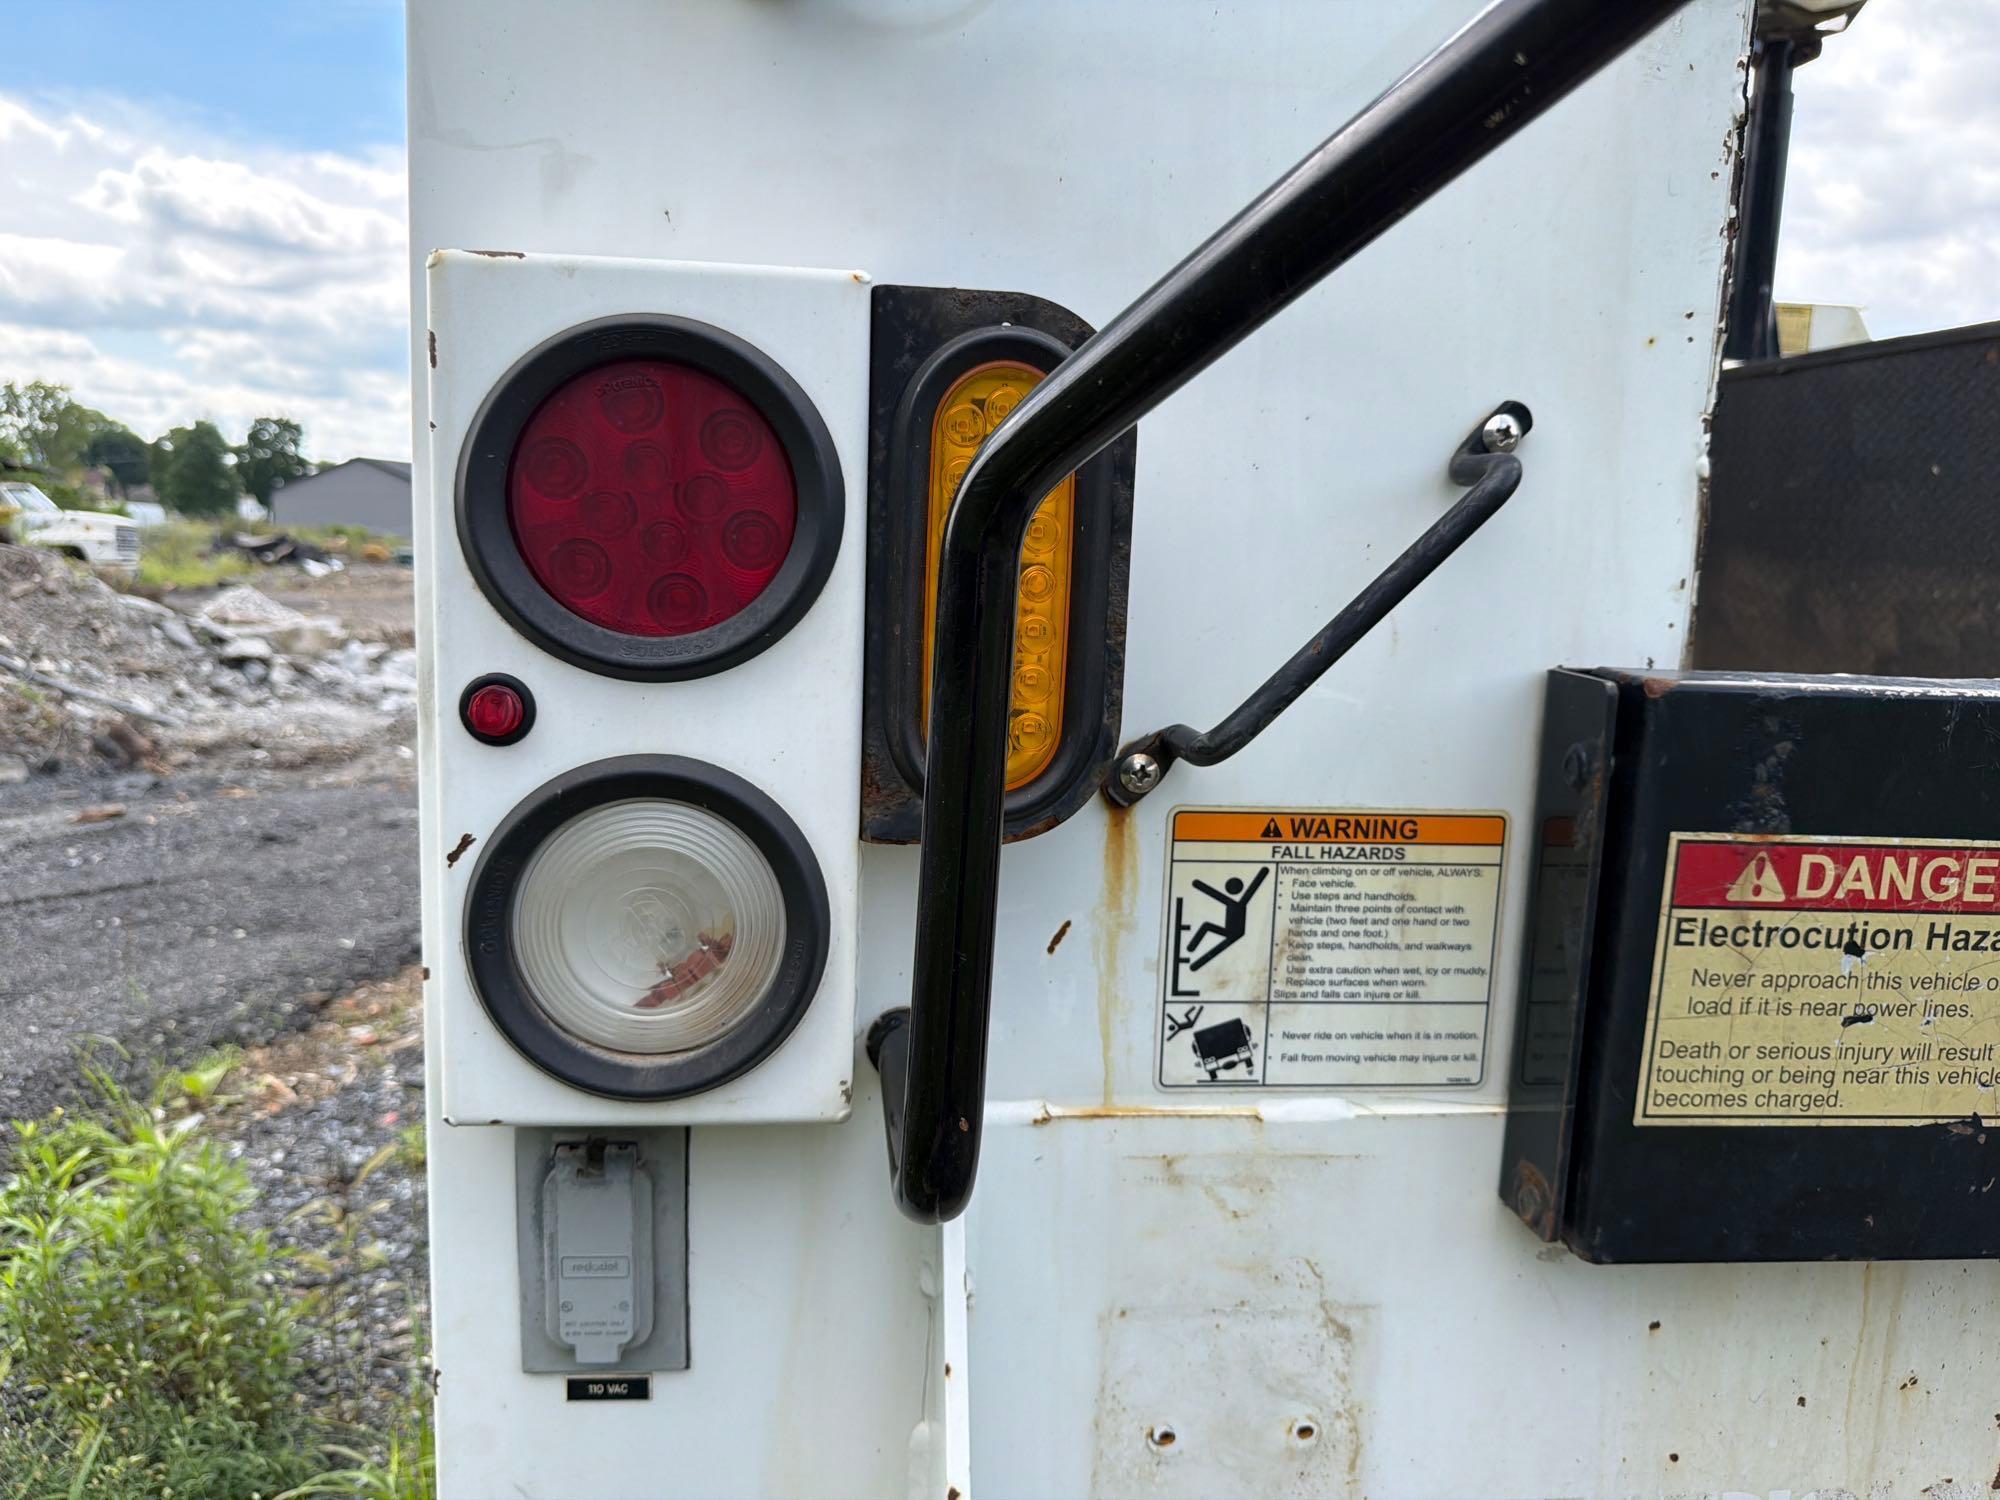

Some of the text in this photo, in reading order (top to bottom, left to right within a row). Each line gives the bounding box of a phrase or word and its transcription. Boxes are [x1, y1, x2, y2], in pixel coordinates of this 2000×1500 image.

[1290, 818, 1419, 840] WARNING
[1271, 846, 1406, 861] FALL HAZARDS
[1280, 866, 1308, 875] When
[1312, 867, 1352, 878] climbing
[1382, 867, 1396, 876] off
[1398, 868, 1435, 878] vehicle,
[1796, 854, 1999, 902] DANGE
[1292, 878, 1356, 888] Face vehicle.
[1291, 891, 1416, 902] Use steps and handholds.
[1290, 903, 1464, 914] Maintain three points of contact with
[1289, 916, 1323, 925] vehicle
[1326, 917, 1346, 926] (two
[1350, 917, 1368, 925] feet
[1371, 917, 1389, 926] and
[1413, 917, 1437, 926] hand
[1452, 918, 1470, 926] two
[1288, 928, 1317, 937] hands
[1320, 929, 1339, 937] and
[1363, 929, 1388, 939] foot.)
[1673, 917, 1913, 952] Electrocution
[1288, 940, 1472, 952] Keep steps, handholds, and walkways
[1286, 953, 1314, 961] clean.
[1286, 965, 1306, 974] Use
[1308, 966, 1333, 974] extra
[1336, 966, 1371, 974] caution
[1373, 966, 1400, 975] when
[1403, 966, 1422, 976] wet,
[1425, 966, 1438, 976] icy
[1453, 967, 1488, 977] muddy.
[1285, 977, 1426, 987] Replace surfaces when worn.
[1691, 968, 1756, 988] Never
[1761, 970, 1859, 993] approach
[1867, 971, 1902, 990] this
[1909, 972, 1980, 991] vehicle
[1273, 989, 1297, 1000] Slips
[1300, 990, 1318, 999] and
[1321, 990, 1341, 999] falls
[1364, 991, 1390, 1000] injure
[1405, 991, 1421, 999] kill.
[1687, 996, 1974, 1020] load if it is near power lines.
[1282, 1031, 1311, 1040] Never
[1314, 1031, 1332, 1040] ride
[1350, 1031, 1383, 1040] vehicle
[1386, 1031, 1412, 1040] when
[1415, 1031, 1421, 1040] it
[1423, 1031, 1431, 1040] is
[1433, 1031, 1441, 1040] in
[1444, 1031, 1478, 1040] motion.
[1281, 1053, 1298, 1062] Fall
[1301, 1053, 1323, 1062] from
[1326, 1054, 1360, 1064] moving
[1363, 1054, 1397, 1062] vehicle
[1399, 1055, 1420, 1064] may
[1422, 1054, 1449, 1063] injure
[1463, 1053, 1479, 1062] kill.
[1659, 1040, 1994, 1066] Death or serious injury will result
[1656, 1065, 1745, 1088] touching
[1751, 1069, 1773, 1084] or
[1779, 1065, 1836, 1089] being
[1843, 1070, 1889, 1085] near
[1895, 1067, 1930, 1085] this
[1652, 1089, 1843, 1112] becomes charged.
[588, 1383, 628, 1394] 110 VAC
